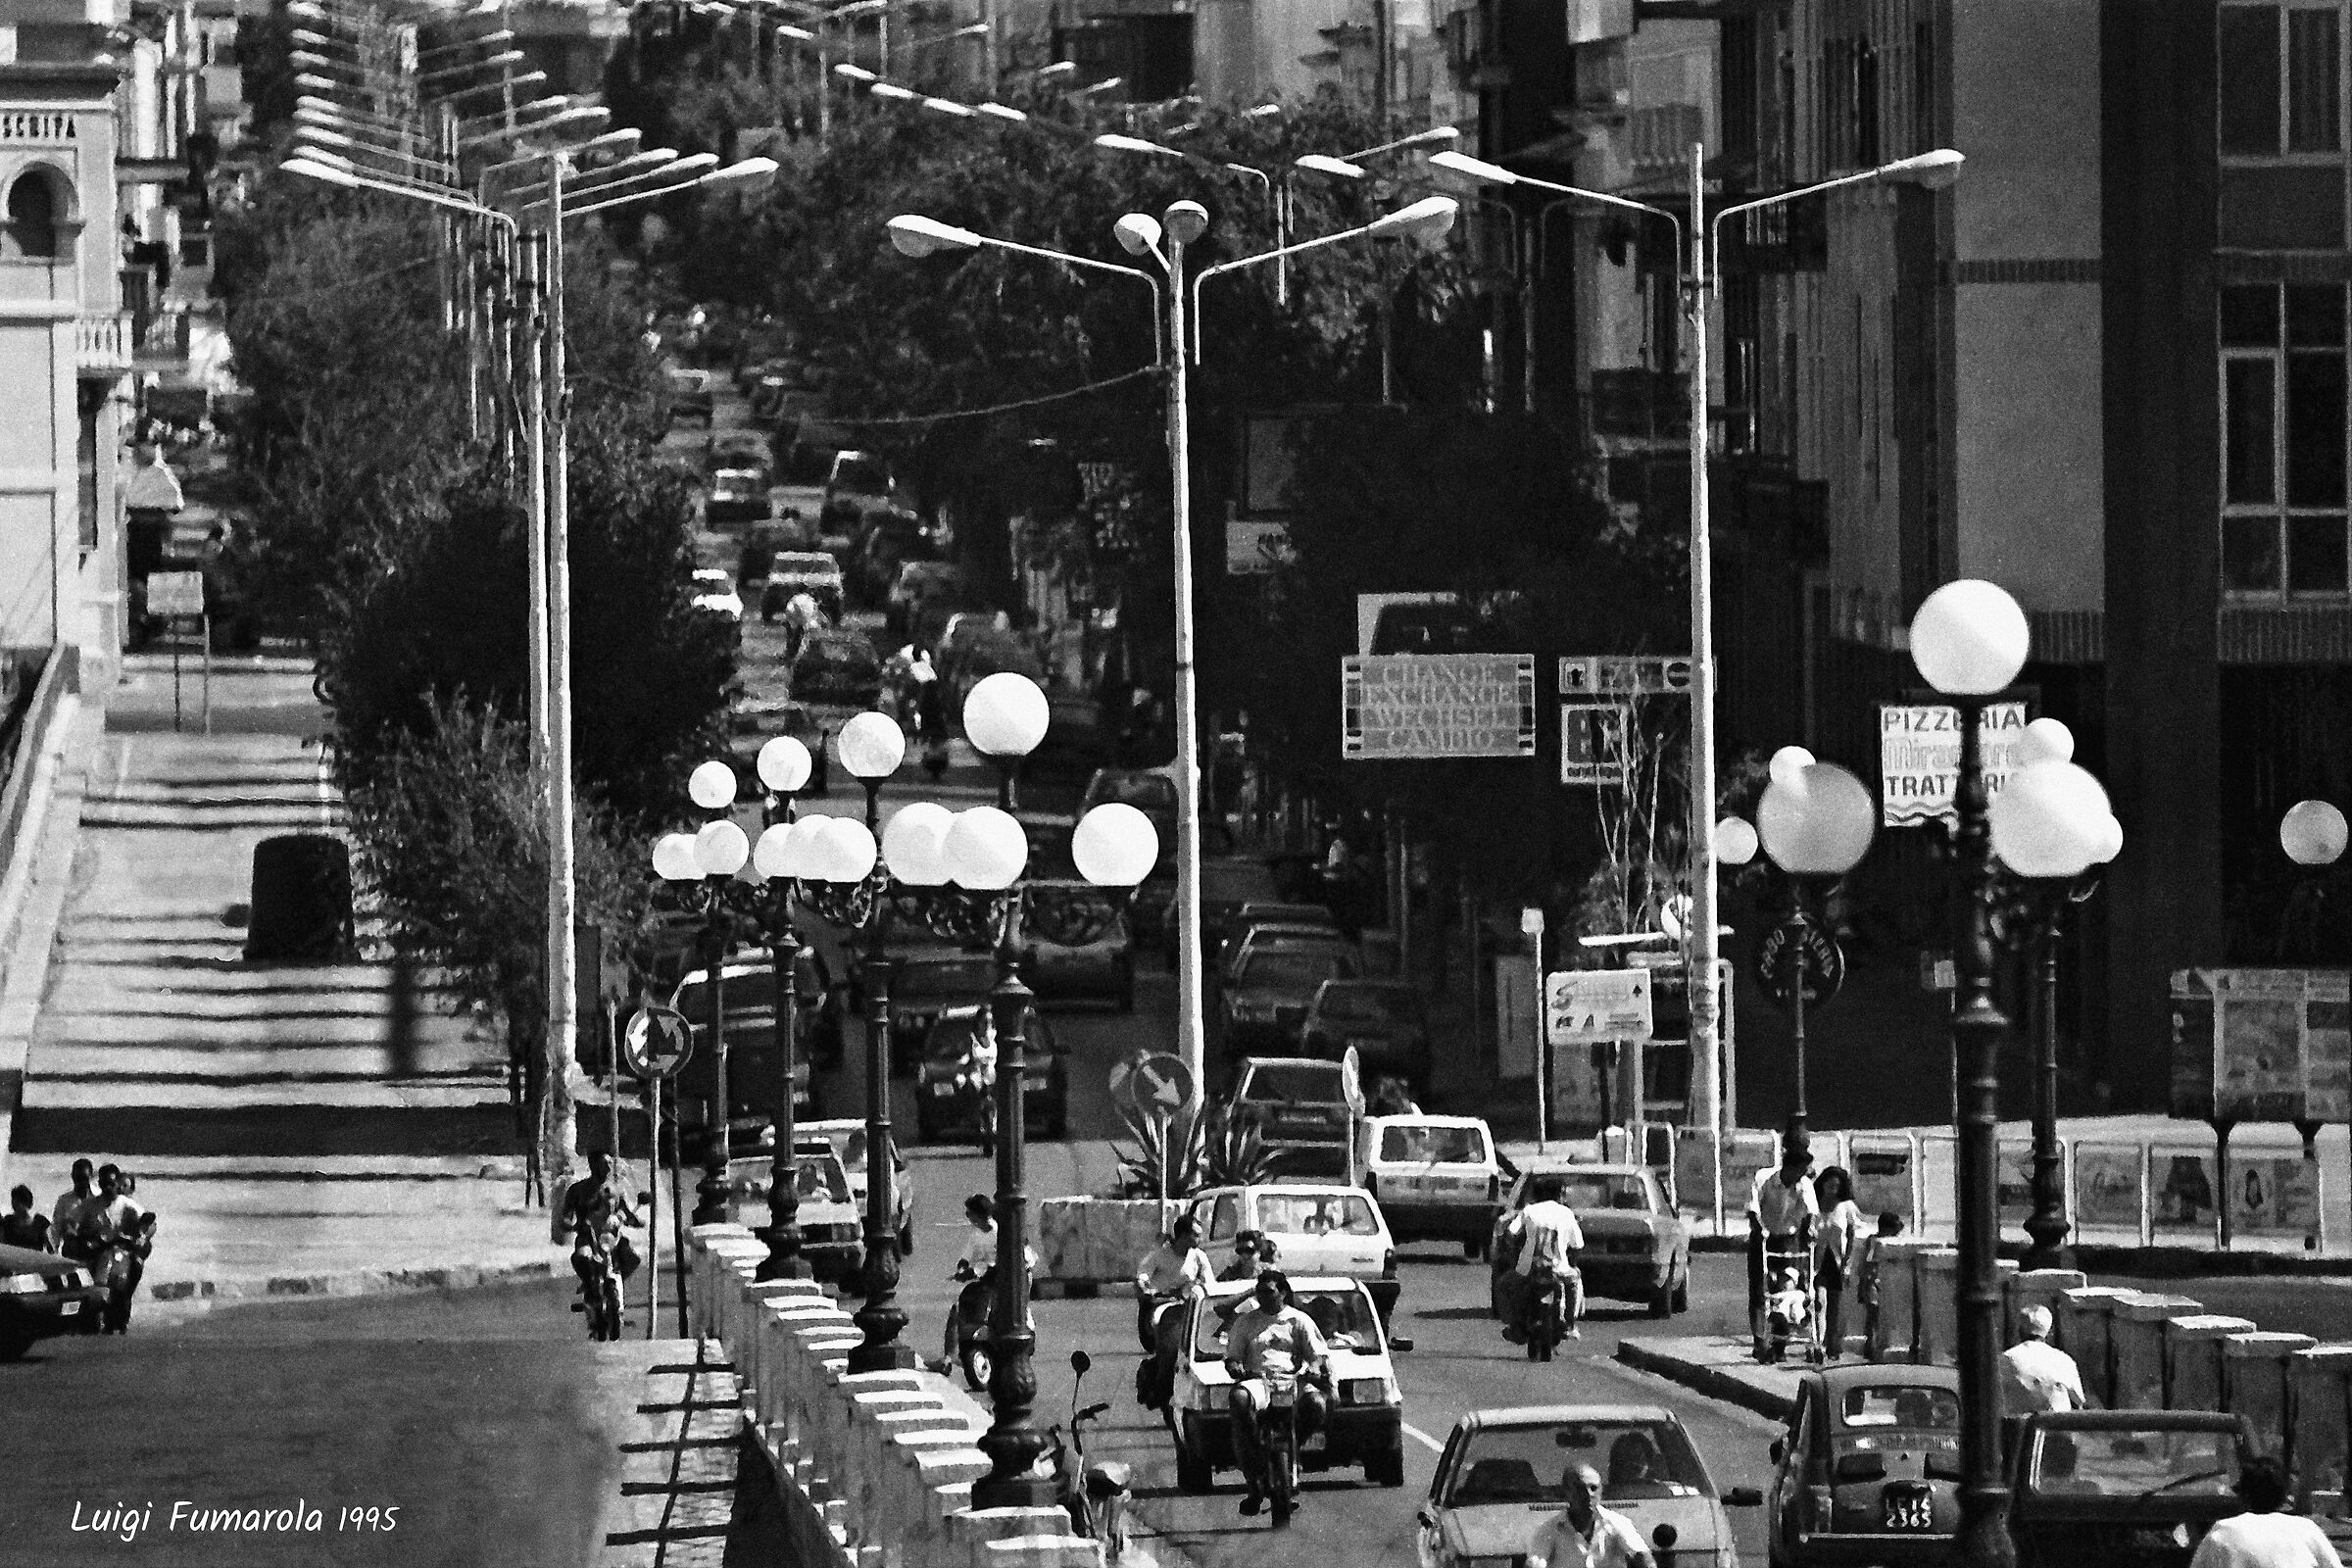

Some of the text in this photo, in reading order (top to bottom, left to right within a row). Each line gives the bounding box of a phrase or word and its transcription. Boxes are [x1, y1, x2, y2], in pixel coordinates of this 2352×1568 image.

[1382, 662, 1498, 685] CHANGE
[1366, 685, 1513, 706] EXCHANGE
[1375, 707, 1507, 728] WECHSEL
[1387, 729, 1495, 751] CAMBIO
